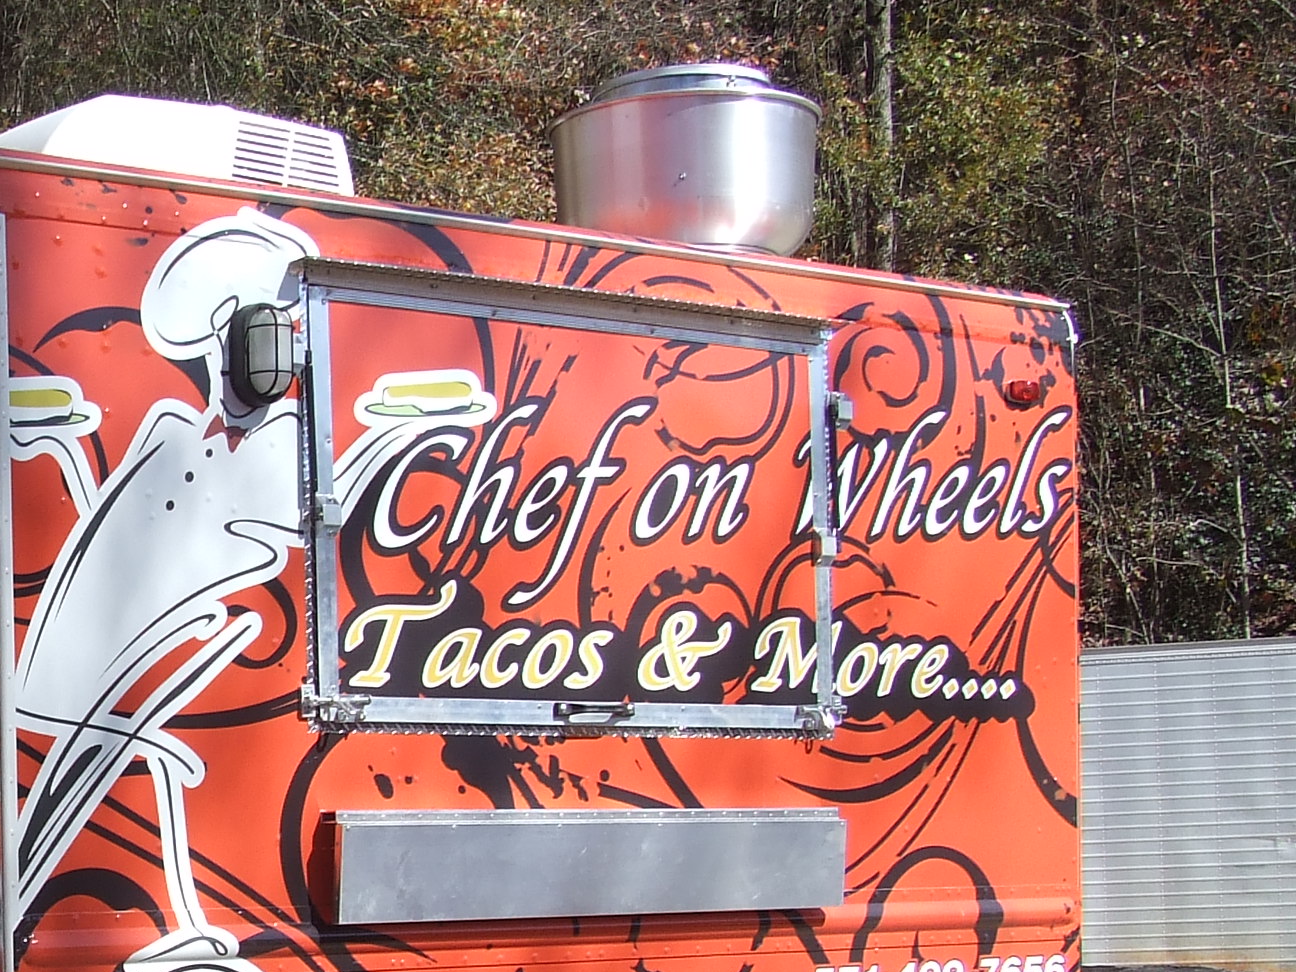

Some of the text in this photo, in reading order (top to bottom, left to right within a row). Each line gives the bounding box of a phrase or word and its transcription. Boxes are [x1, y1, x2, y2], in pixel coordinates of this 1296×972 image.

[372, 403, 1073, 606] Chef on Wheels
[344, 579, 615, 691] Tacos
[637, 609, 733, 691] &
